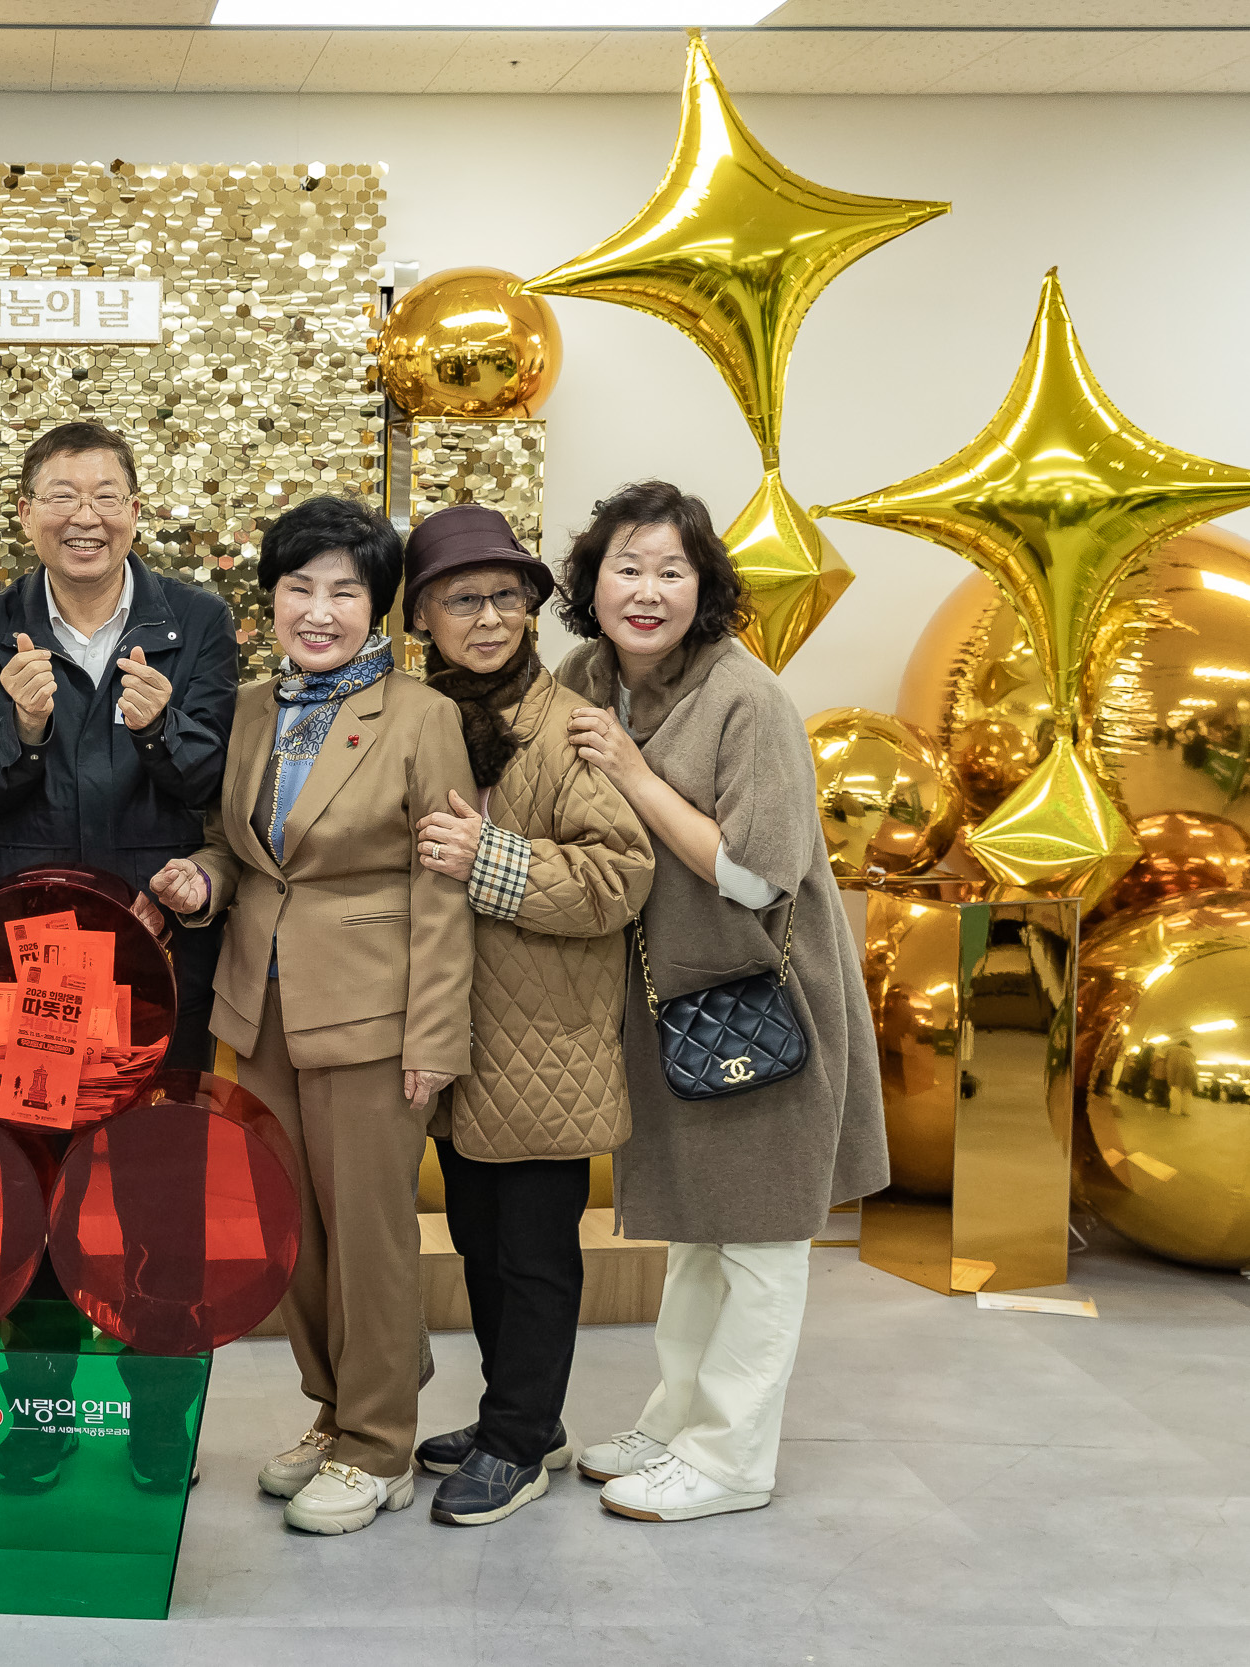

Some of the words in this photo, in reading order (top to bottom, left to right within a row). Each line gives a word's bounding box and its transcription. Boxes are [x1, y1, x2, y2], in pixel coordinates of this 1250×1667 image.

[95, 288, 134, 328] 날
[19, 942, 39, 952] 2026
[25, 987, 47, 998] 2026
[22, 997, 82, 1023] 따뜻한
[8, 1398, 77, 1423] 사랑의
[81, 1399, 132, 1424] 열매
